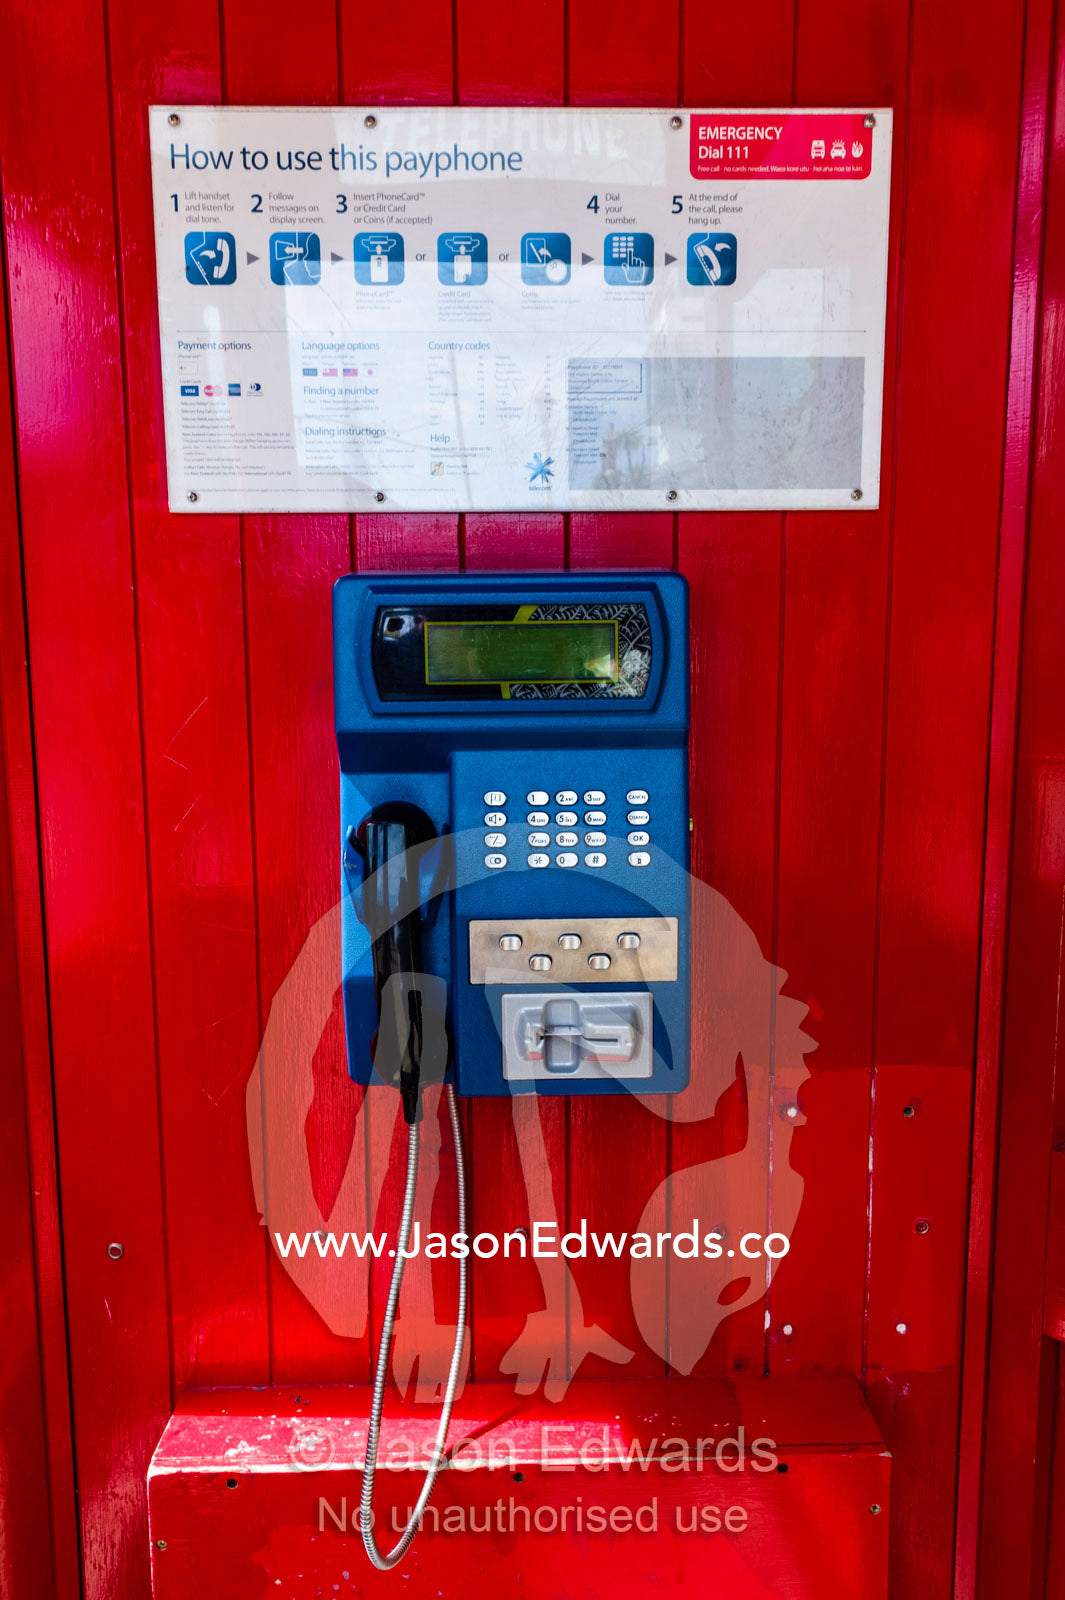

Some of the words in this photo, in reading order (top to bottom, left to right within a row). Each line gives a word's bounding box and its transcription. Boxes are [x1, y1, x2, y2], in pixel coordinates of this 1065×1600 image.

[698, 126, 783, 140] EMERGENCY
[698, 145, 723, 160] Dial
[726, 146, 749, 159] 111
[170, 143, 233, 171] How
[240, 147, 268, 171] to
[276, 150, 322, 171] use
[329, 143, 377, 171] this
[385, 143, 523, 179] payphone
[184, 192, 197, 202] Lift
[198, 192, 230, 202] handset
[268, 192, 294, 202] Follow
[353, 192, 375, 202] Insert
[605, 193, 620, 202] Dial
[689, 193, 697, 202] At
[698, 193, 710, 202] the
[712, 193, 727, 202] end
[729, 193, 738, 202] of
[170, 194, 179, 213] 1
[185, 203, 200, 213] and
[202, 203, 222, 213] listen
[223, 203, 235, 213] for
[250, 194, 264, 213] 2
[335, 194, 348, 213] 3
[353, 205, 362, 213] or
[363, 203, 387, 213] Credit
[387, 203, 406, 213] Card
[586, 195, 600, 214] 4
[671, 195, 684, 214] 5
[269, 205, 306, 215] messages
[308, 205, 319, 213] on
[605, 205, 623, 214] your
[689, 205, 700, 213] the
[718, 205, 743, 215] please
[185, 215, 199, 225] dial
[200, 215, 222, 225] tone.
[269, 215, 297, 226] display
[298, 216, 325, 225] screen.
[353, 217, 362, 225] or
[363, 215, 385, 225] Coins
[386, 215, 395, 226] (if
[396, 215, 433, 226] accepted)
[605, 215, 637, 225] number.
[689, 216, 707, 226] hang
[708, 217, 721, 226] up.
[415, 253, 427, 262] or
[498, 253, 510, 262] or
[178, 341, 216, 352] Payment
[218, 341, 251, 352] options
[301, 341, 345, 352] Language
[346, 341, 380, 352] options
[428, 341, 464, 352] Country
[465, 341, 490, 351] codes
[303, 386, 335, 398] Finding
[344, 386, 380, 395] number
[304, 427, 335, 438] Dialing
[336, 427, 387, 437] instructions
[430, 434, 450, 444] Help
[559, 794, 564, 802] 2
[587, 794, 592, 802] 3
[530, 815, 536, 823] 4
[559, 815, 564, 823] 5
[587, 814, 592, 822] 6
[559, 835, 564, 843] 8
